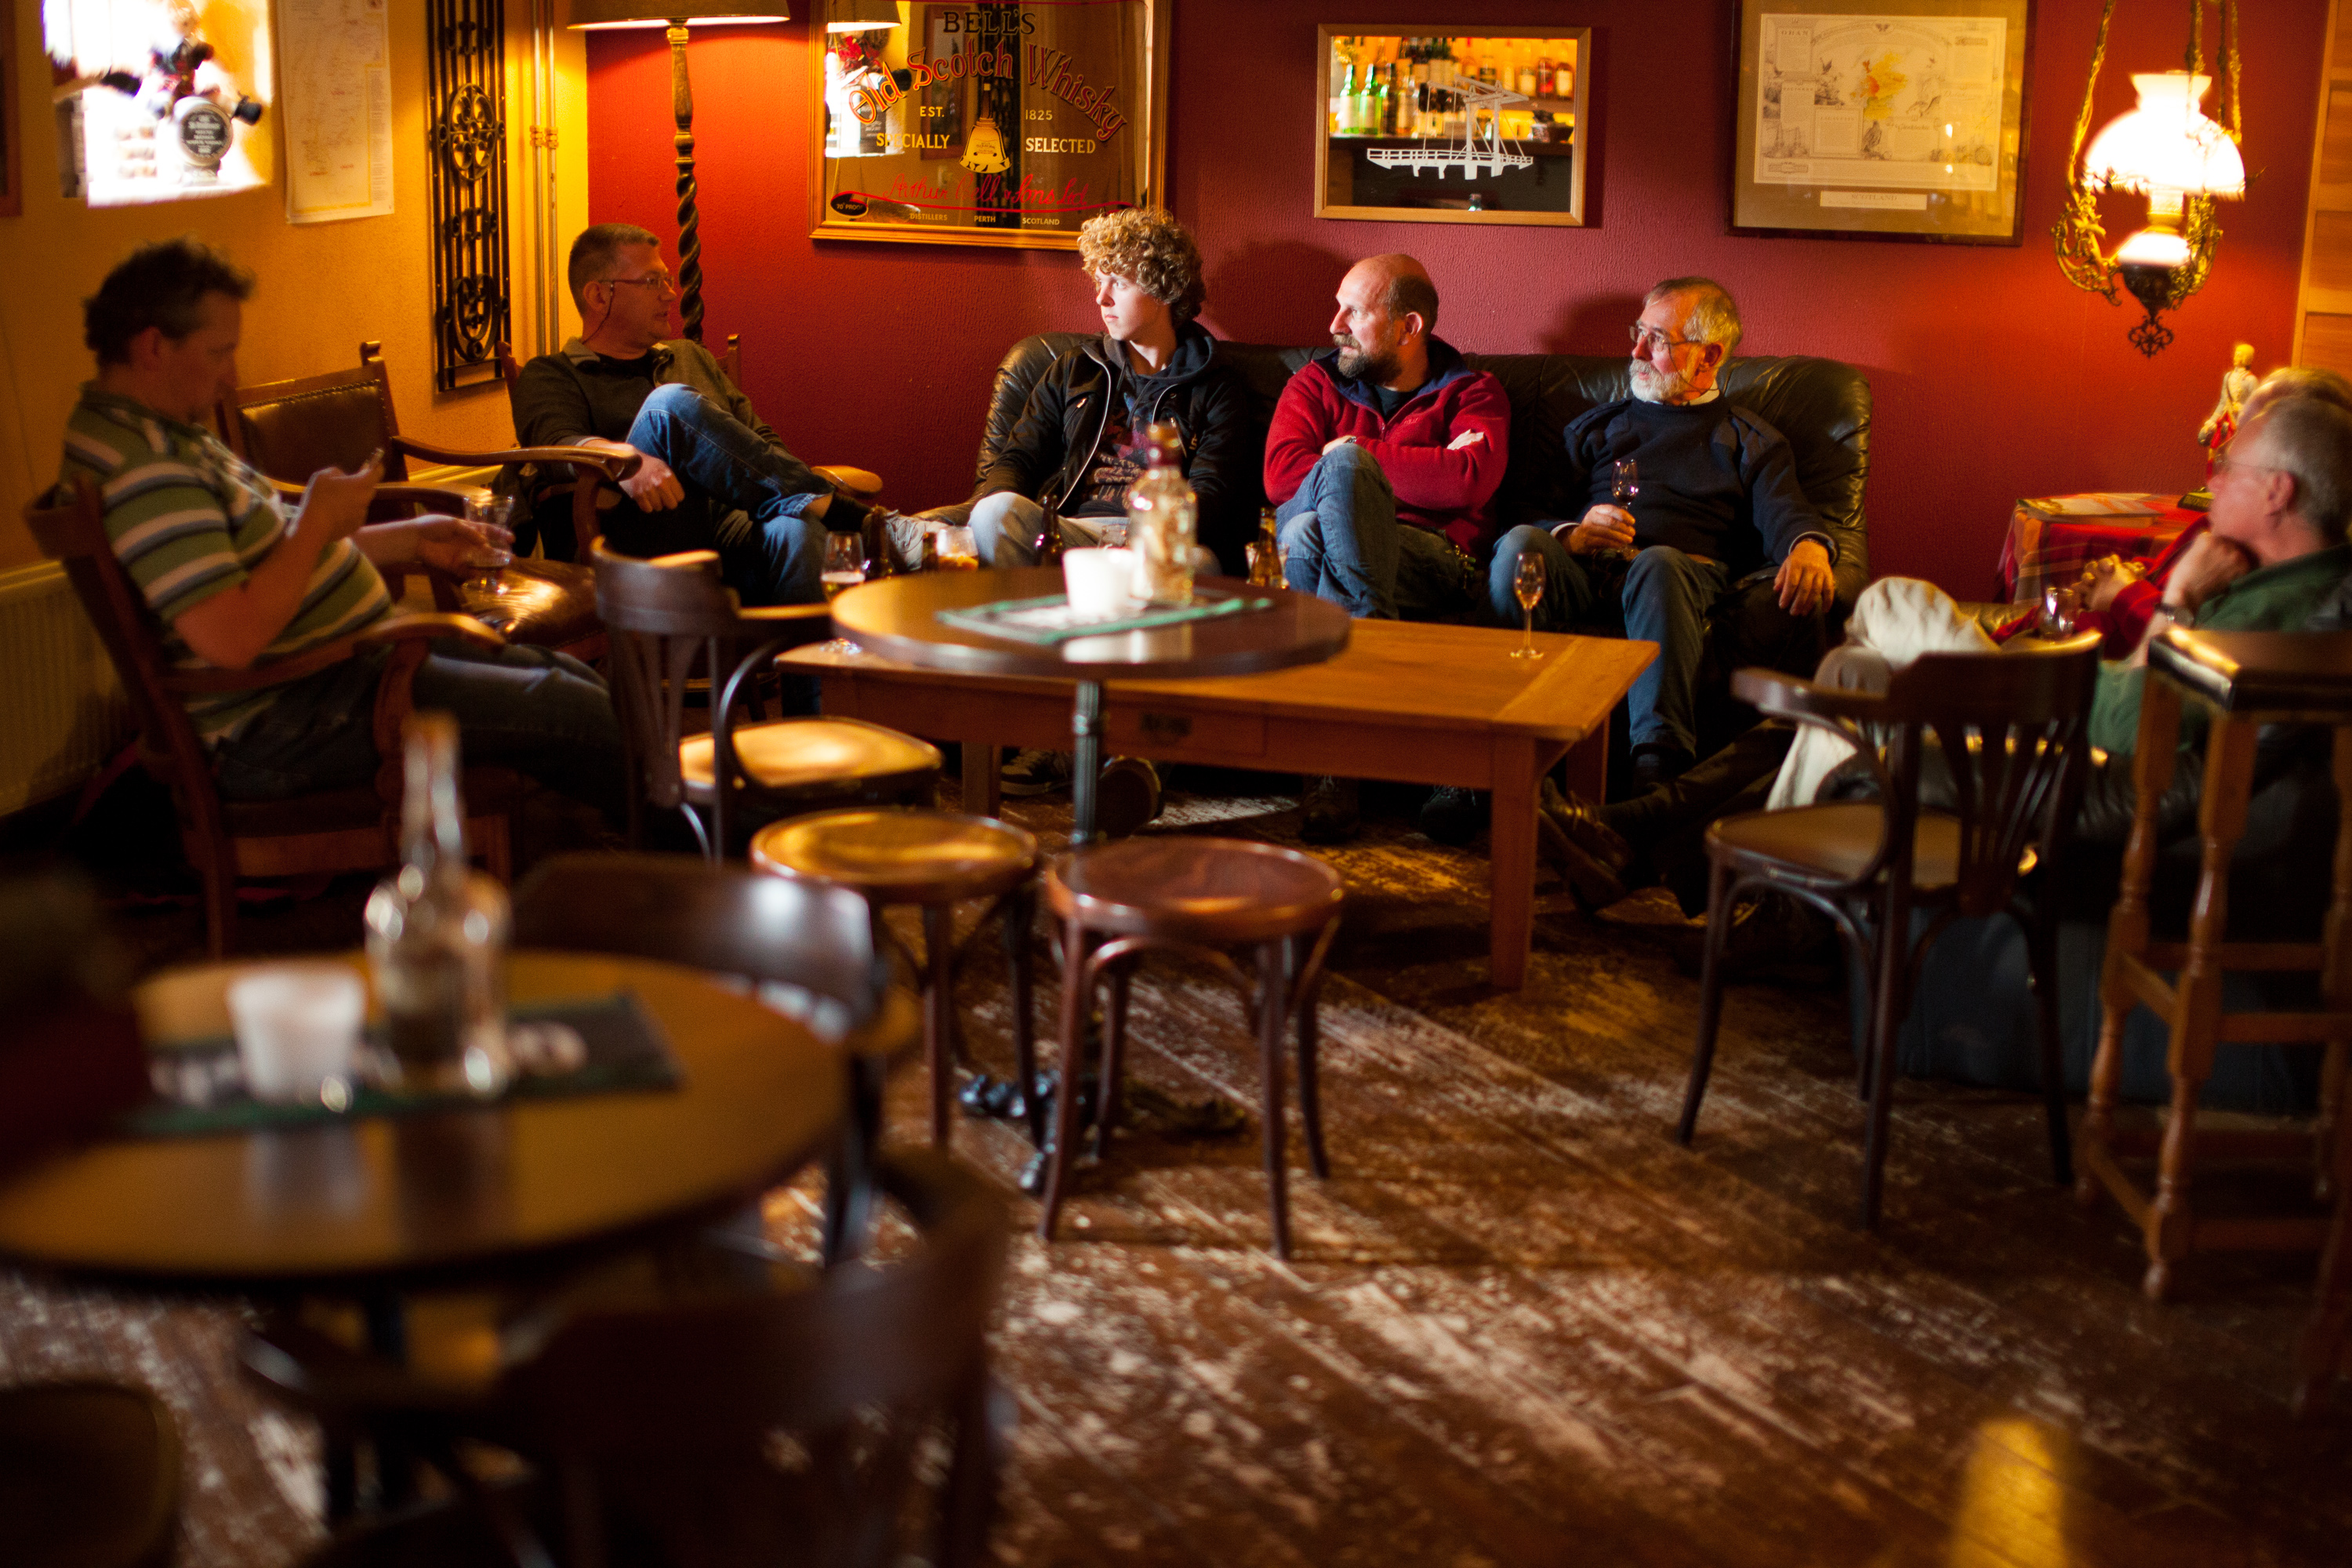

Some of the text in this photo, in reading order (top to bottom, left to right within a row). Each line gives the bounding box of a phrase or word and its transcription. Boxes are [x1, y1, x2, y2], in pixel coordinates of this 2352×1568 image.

[943, 9, 1036, 34] BELL'S
[849, 61, 906, 124] Old
[906, 38, 1014, 90] Scotch
[1026, 41, 1127, 141] Whisky
[920, 106, 1053, 121] EST. 1825
[877, 132, 1095, 154] SPECIALLY SELECTED
[883, 173, 949, 199] Arthur
[956, 172, 1001, 202] Bell
[1011, 173, 1055, 205] Sons
[910, 212, 948, 221] DISTILLERS
[1022, 217, 1060, 226] SCOTLAND
